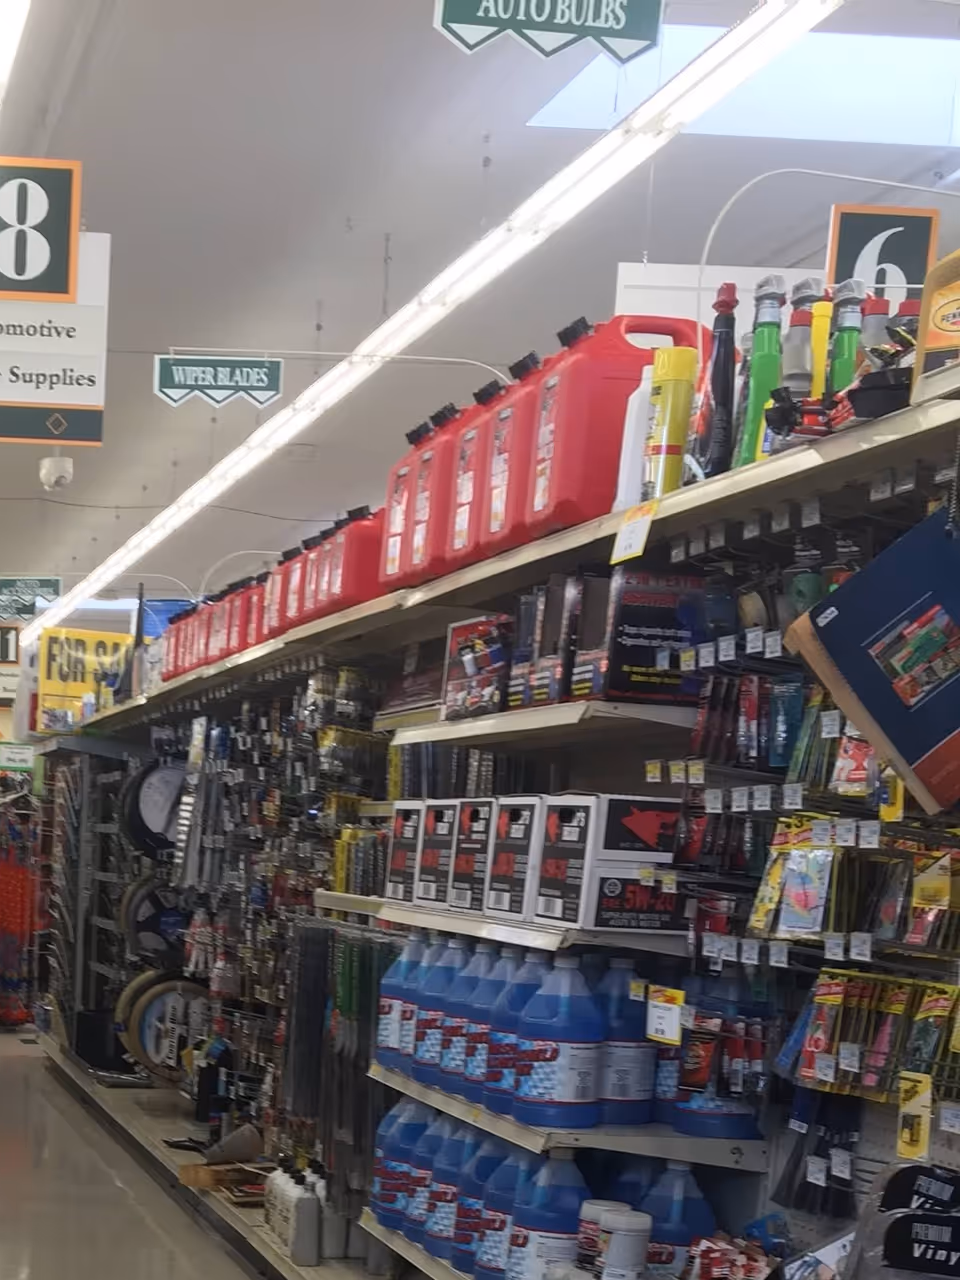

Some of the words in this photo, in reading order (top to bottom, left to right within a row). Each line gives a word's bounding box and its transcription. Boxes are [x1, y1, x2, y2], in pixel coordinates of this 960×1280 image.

[553, 0, 628, 30] BULBS
[853, 226, 908, 318] 6
[9, 366, 97, 389] Supplies
[171, 366, 215, 385] WIPER
[216, 367, 269, 387] BLADES
[46, 635, 87, 684] FOR
